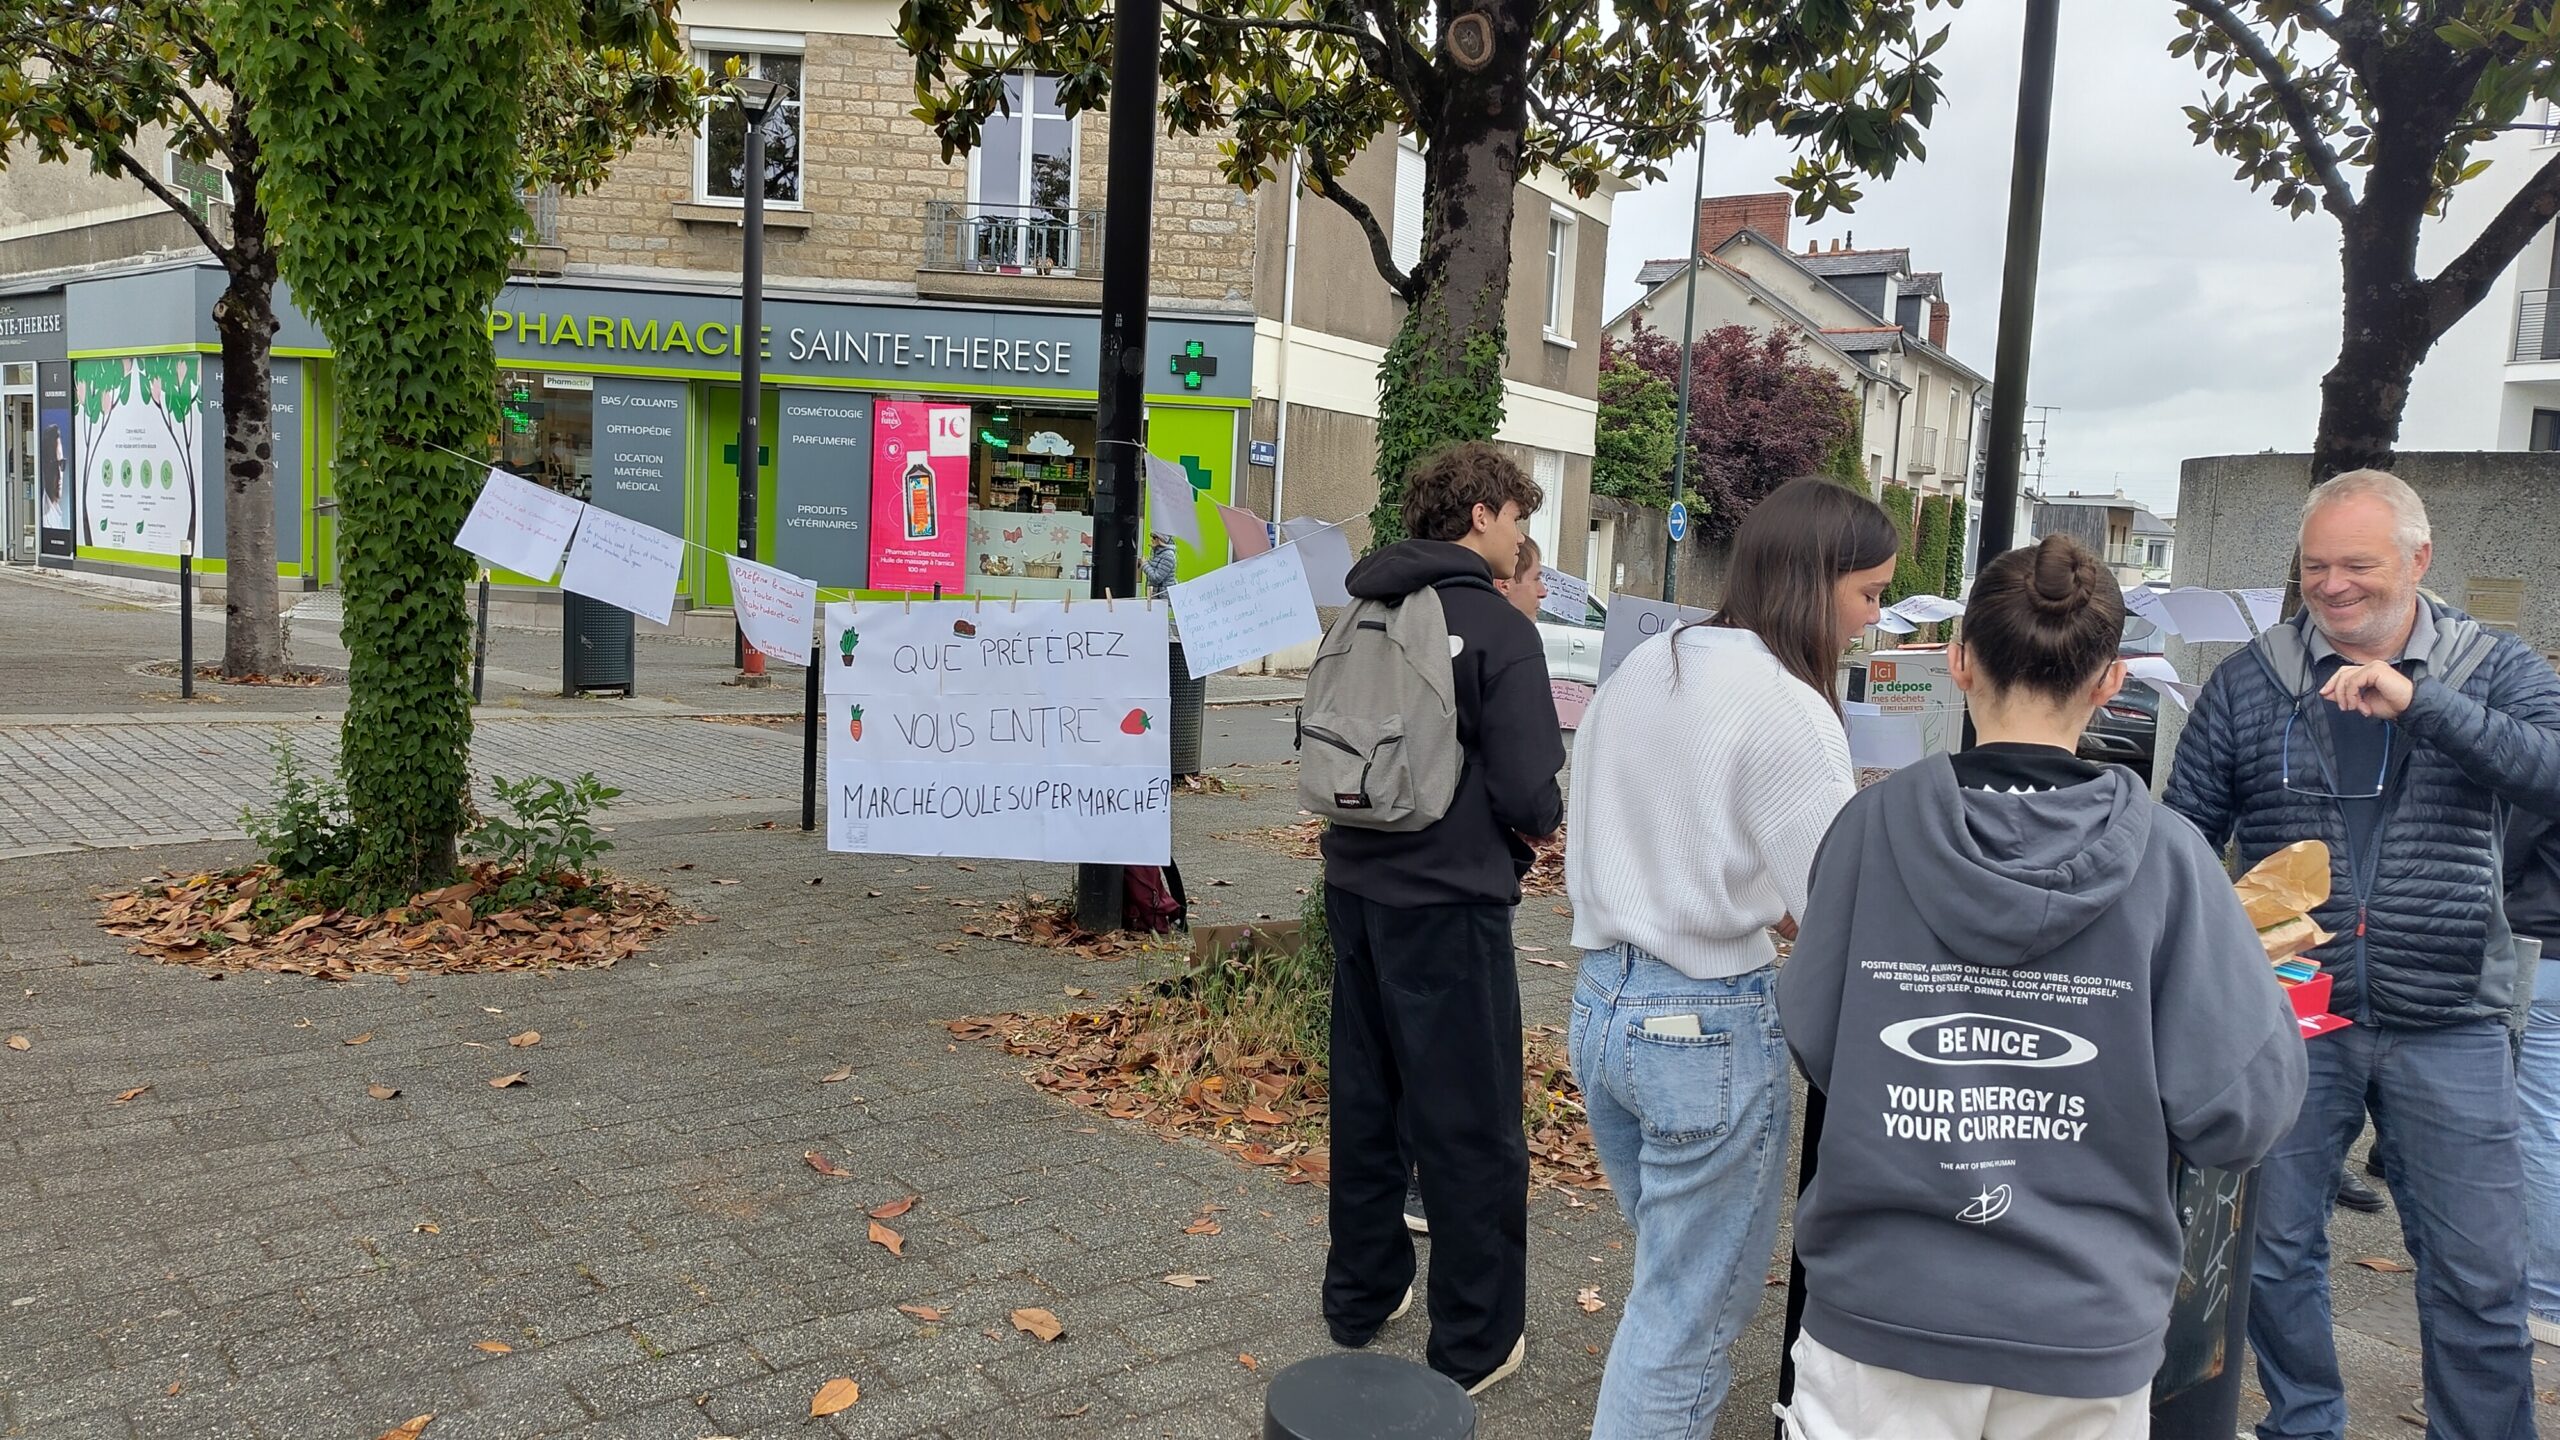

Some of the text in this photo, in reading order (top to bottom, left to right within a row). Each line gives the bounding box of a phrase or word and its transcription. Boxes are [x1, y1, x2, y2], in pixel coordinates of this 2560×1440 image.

[487, 310, 1071, 374] PHARMACIE SAINTE-THERESE
[547, 377, 590, 387] Pharmactiv
[601, 395, 621, 405] BAS
[630, 397, 678, 408] COLLANTS
[787, 406, 863, 419] COSMÉTOLOGIE
[606, 424, 671, 436] ORTHOPÉDIE
[792, 434, 856, 446] PARFUMERIE
[614, 453, 663, 464] LOCATION
[614, 467, 663, 478] MATÉRIEL
[616, 480, 660, 492] MÉDICAL
[797, 504, 848, 515] PRODUITS
[787, 518, 858, 530] VÉTÉRINAIRES
[893, 630, 1130, 675] QUE PRÉFÉREZ
[1874, 664, 1892, 679] Ici
[1872, 681, 1932, 694] je dépose
[1890, 694, 1925, 703] déchets
[893, 705, 1102, 753] VOUS ENTRE
[843, 781, 938, 820] MARCHÉ
[1861, 960, 2134, 992] POSITIVE ENERGY, ALWAYS ON FLEEK. GOOD VIBES, GOOD TIMES,
[1873, 971, 2119, 998] AND ZERO BAD ENERGY ALLOWED. LOOK AFTER YOURSELF.
[1900, 983, 2089, 1006] GET LOTS OF SLEEP. DRINK PLENTY OF WATER
[1937, 1026, 2040, 1058] BE NICE
[1886, 1084, 2086, 1117] YOUR ENERGY IS
[1882, 1112, 2088, 1143] YOUR CURRENCY
[1940, 1162, 1954, 1170] THE
[1955, 1162, 1970, 1170] ART
[1970, 1162, 1980, 1170] OF
